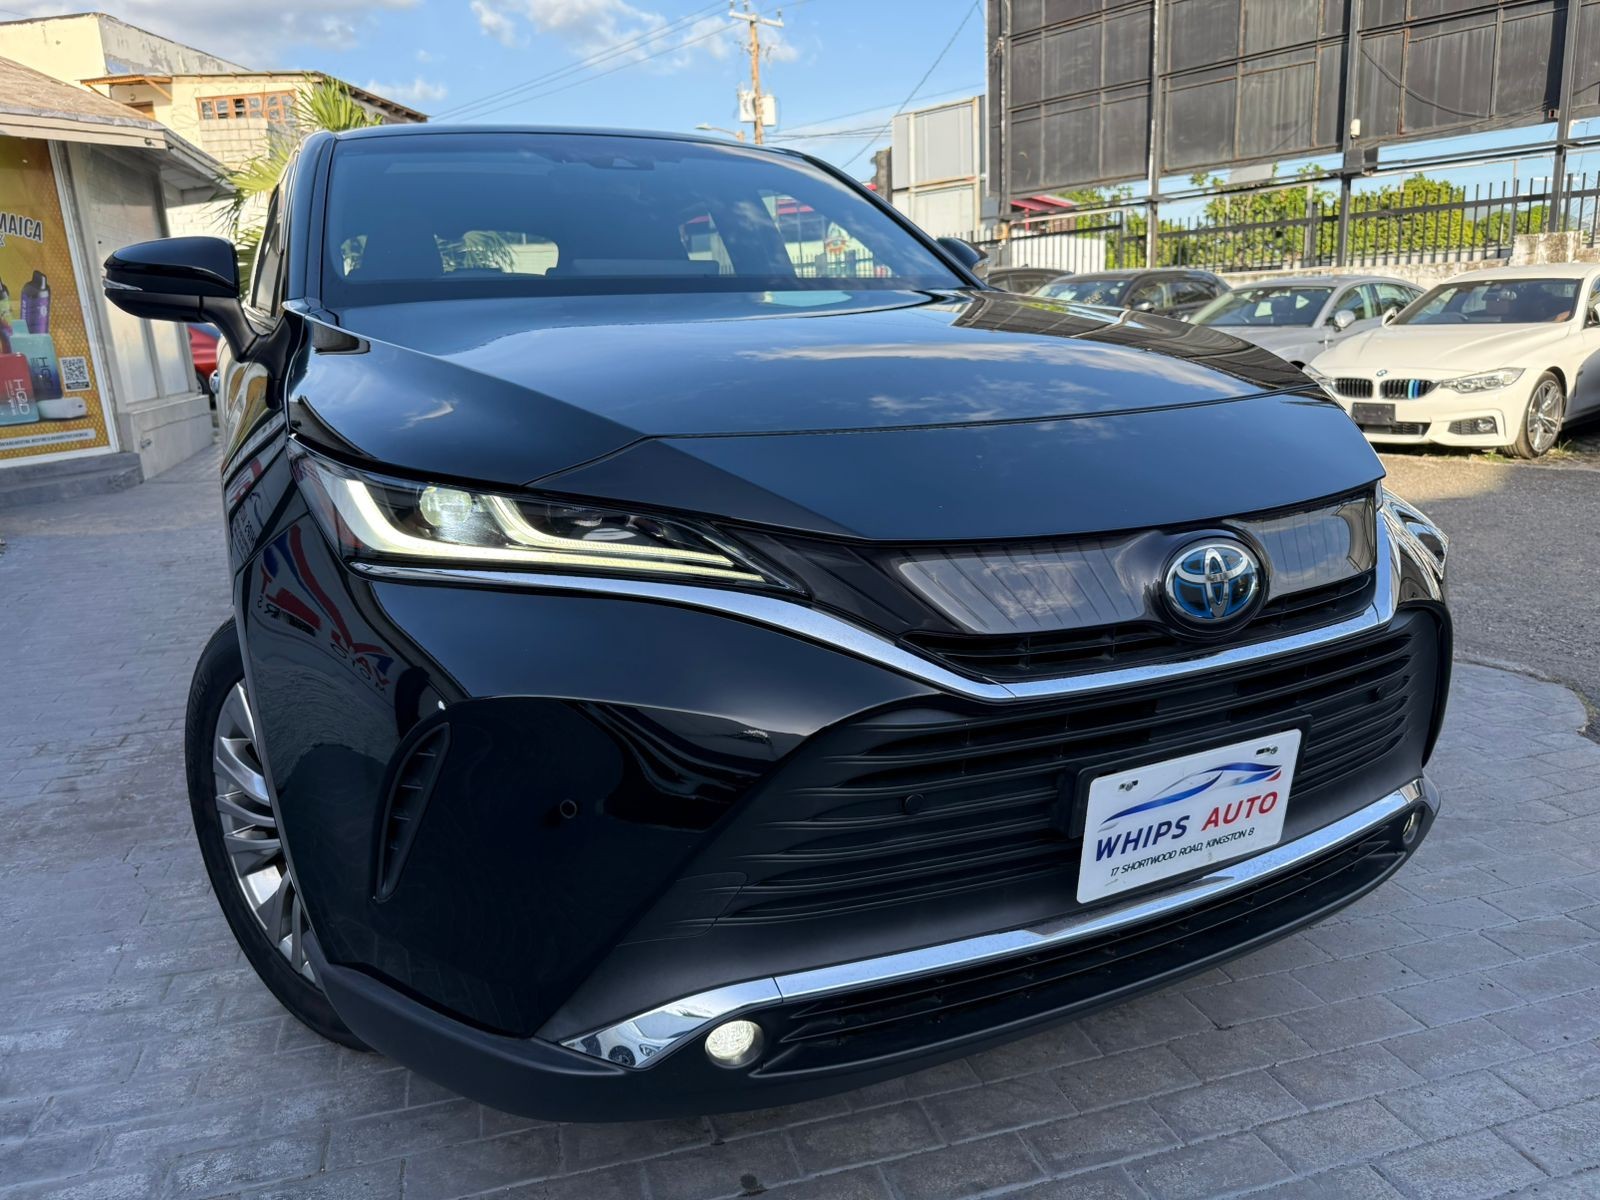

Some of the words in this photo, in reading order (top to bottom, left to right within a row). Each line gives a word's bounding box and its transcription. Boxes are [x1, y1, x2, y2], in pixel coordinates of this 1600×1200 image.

[1095, 815, 1190, 862] WHIPS
[1201, 791, 1278, 832] AUTO
[1110, 866, 1120, 877] 17
[1120, 850, 1177, 874] SHORTWOOD
[1205, 830, 1246, 848] KINGSTON
[1247, 827, 1255, 836] 8
